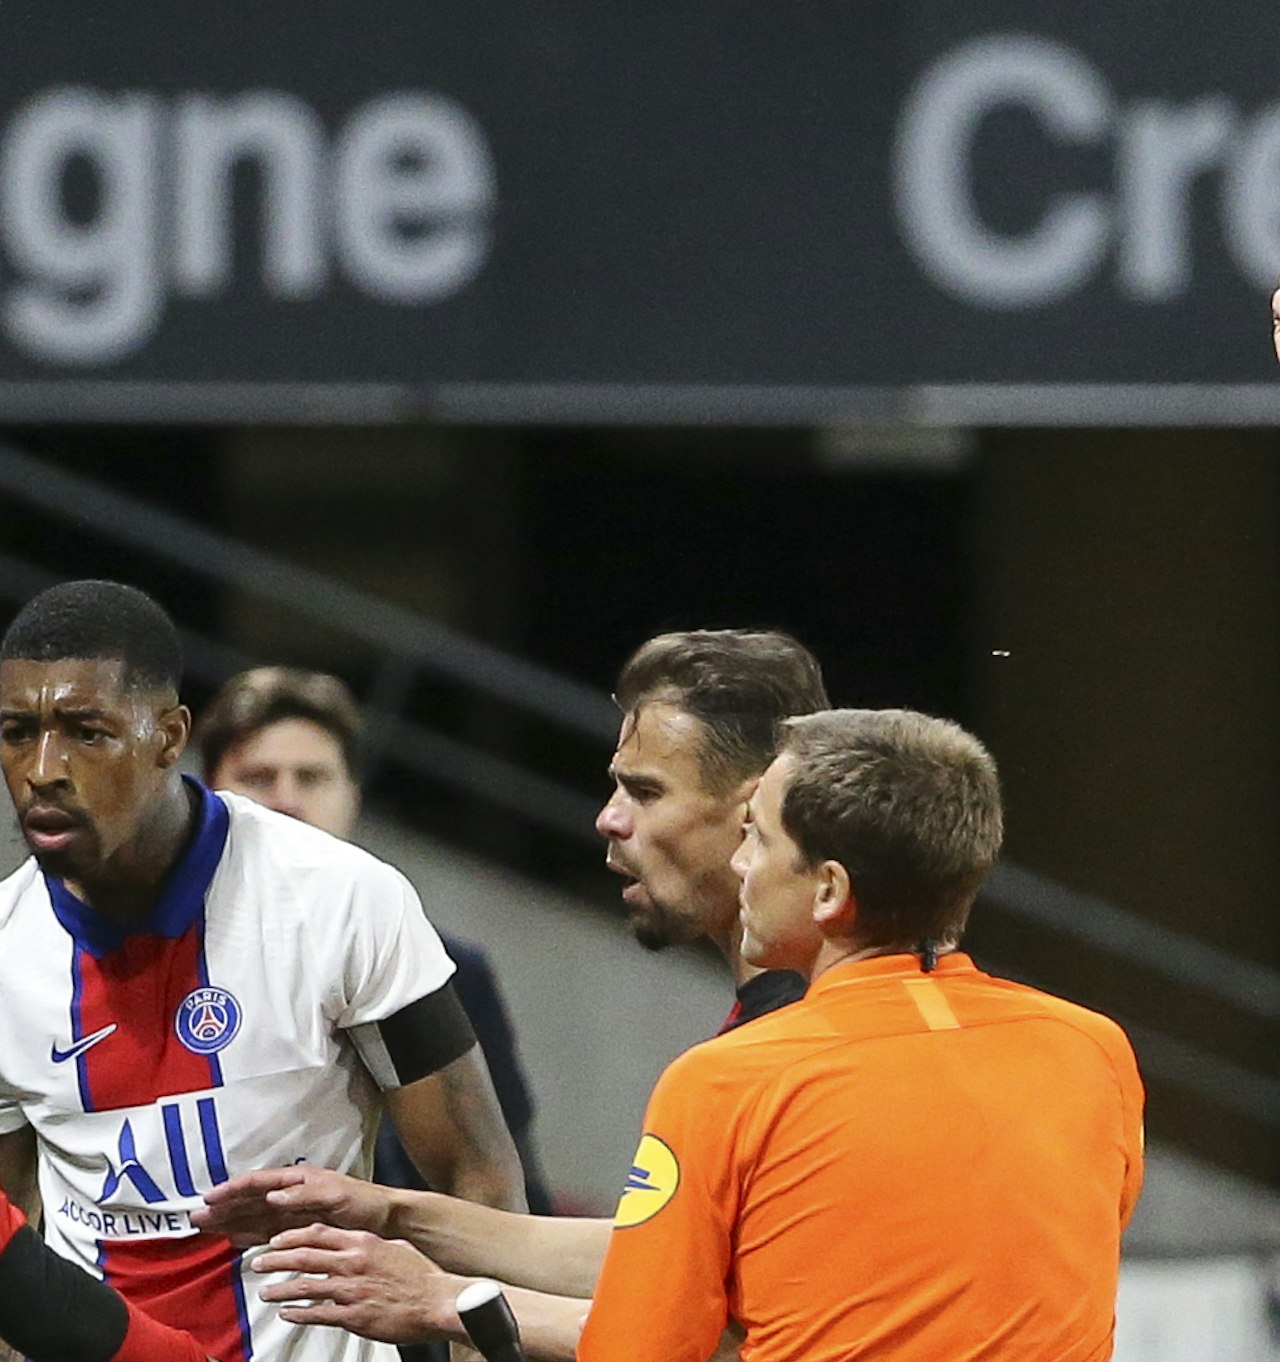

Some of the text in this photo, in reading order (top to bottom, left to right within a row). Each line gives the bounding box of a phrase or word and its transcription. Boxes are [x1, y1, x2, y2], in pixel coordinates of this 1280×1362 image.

[185, 991, 228, 1010] PARIS
[58, 1196, 118, 1234] ACCOR
[124, 1213, 181, 1234] LIVE
